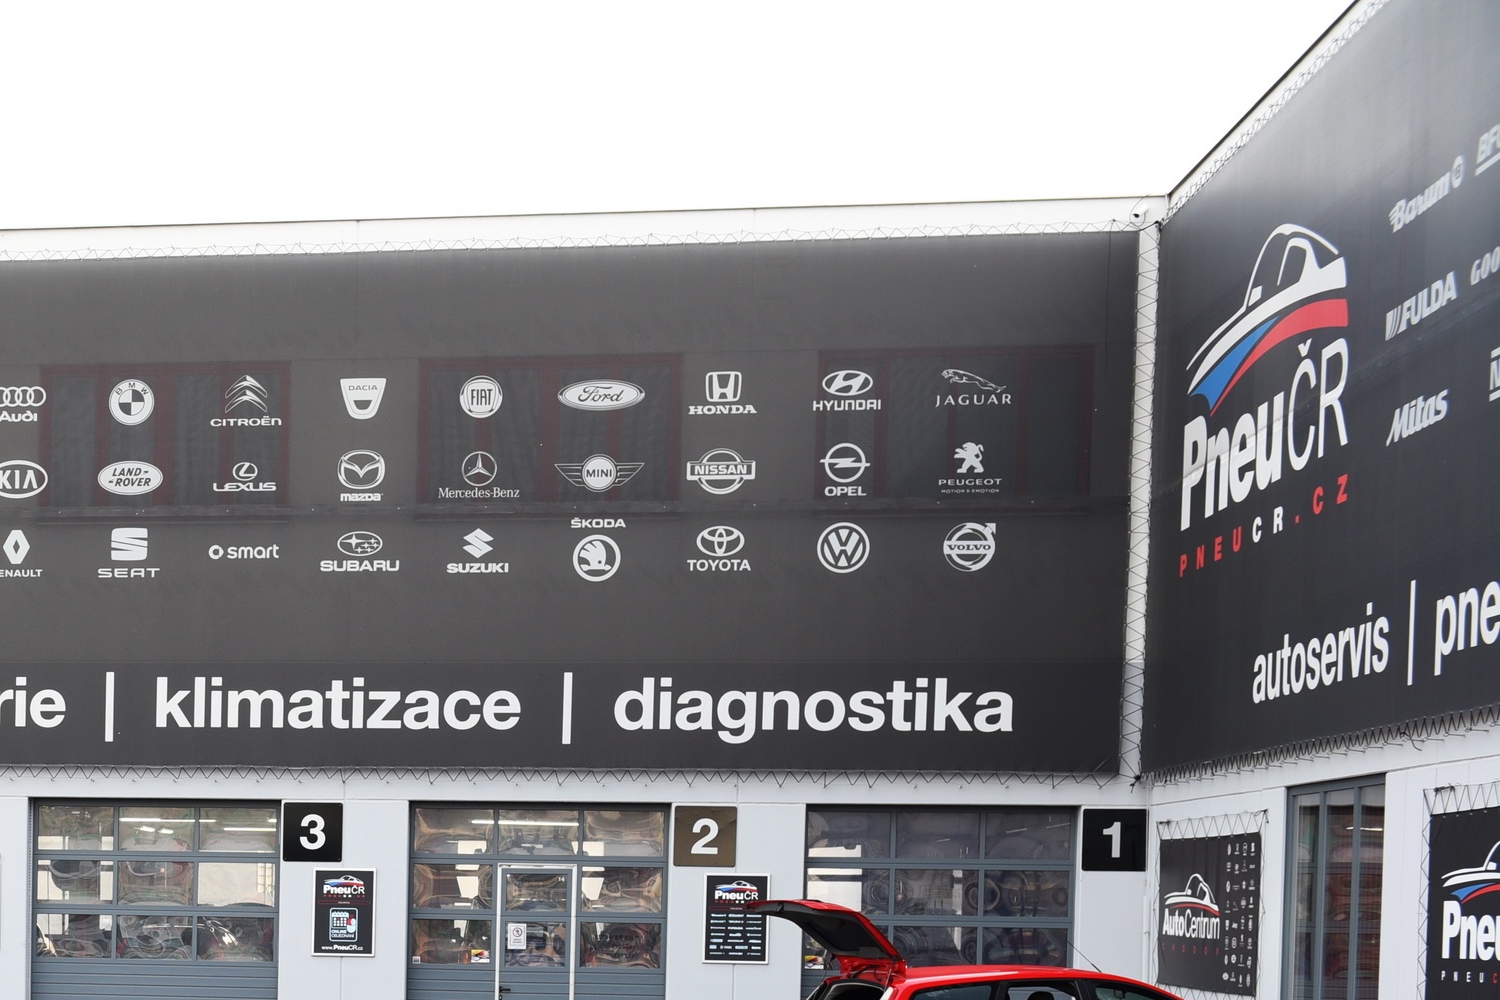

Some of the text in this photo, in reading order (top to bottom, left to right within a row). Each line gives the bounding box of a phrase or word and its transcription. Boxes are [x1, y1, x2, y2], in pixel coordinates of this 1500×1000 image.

[1391, 171, 1450, 233] Barum
[1397, 270, 1458, 334] FULDA
[470, 388, 493, 407] FIAT
[577, 385, 624, 403] Ford
[935, 393, 1012, 408] JAGUAR
[688, 405, 757, 415] HONDA
[812, 399, 881, 411] HYUNDAI
[210, 415, 282, 427] CITROËN
[1386, 388, 1449, 447] Mitas
[1180, 337, 1348, 531] PneuČR
[111, 467, 142, 478] LAND
[585, 468, 613, 478] MINI
[694, 464, 747, 475] NISSAN
[114, 477, 152, 487] ROVER
[212, 482, 277, 492] LEXUS
[938, 478, 1002, 486] PEUGEOT
[340, 492, 382, 502] mazda
[438, 486, 520, 499] Mercedes-Benz
[824, 486, 867, 497] OPEL
[570, 517, 627, 528] ŠKODA
[1180, 474, 1348, 578] PNEUCR.CZ
[226, 544, 279, 559] smart
[320, 560, 400, 572] SUBARU
[446, 563, 509, 573] SUZUKI
[687, 559, 752, 572] TOYOTA
[97, 567, 160, 578] SEAT
[1252, 602, 1389, 704] autoservis
[155, 675, 522, 731] klimatizace
[613, 676, 1015, 744] diagnostika
[300, 813, 326, 850] 3
[690, 817, 718, 855] 2
[1103, 821, 1122, 858] 1
[1162, 908, 1220, 940] AutoCentrum
[1441, 900, 1500, 961] Pne
